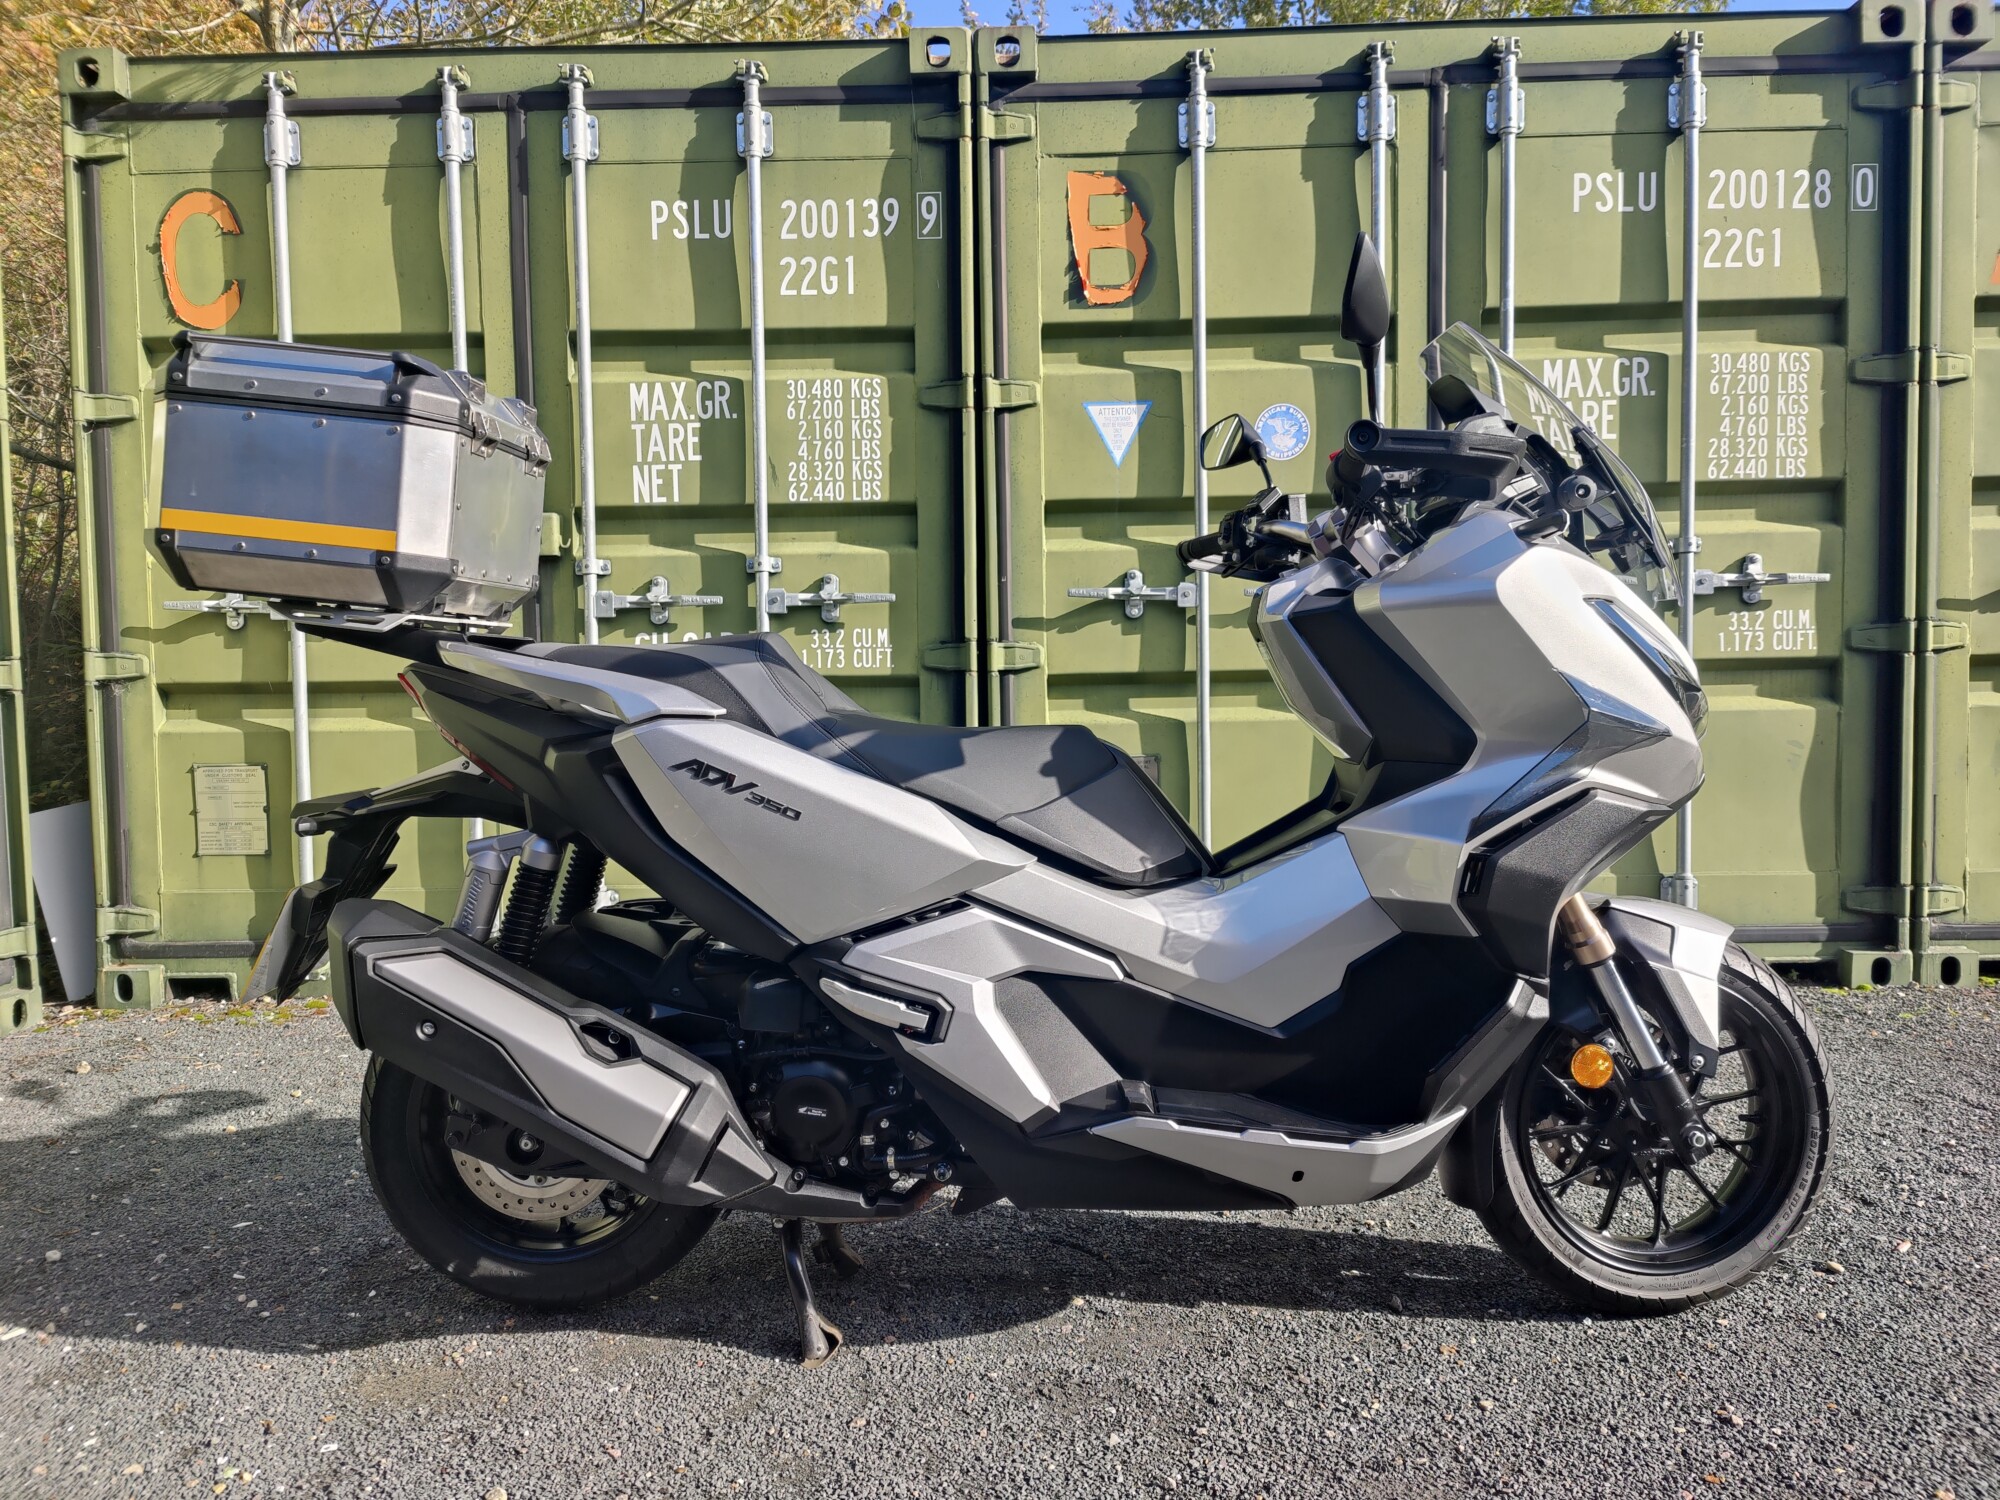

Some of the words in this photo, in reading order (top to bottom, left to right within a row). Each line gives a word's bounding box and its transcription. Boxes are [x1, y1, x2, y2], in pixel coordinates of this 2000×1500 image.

[1573, 171, 1657, 213] PSLU
[1707, 168, 1831, 210] 200128
[1855, 167, 1875, 208] 0
[650, 199, 731, 240] PSLU
[780, 198, 900, 240] 200139
[920, 195, 938, 236] 9
[1703, 227, 1782, 269] 22G1
[160, 190, 241, 330] C
[779, 255, 855, 296] 22G1
[1710, 352, 1770, 374] 30,480
[1778, 351, 1811, 373] KGS
[786, 379, 843, 400] 30,480
[851, 378, 882, 398] KGS
[1709, 373, 1770, 395] 67,200
[1777, 373, 1808, 394] LBS
[629, 380, 738, 422] MAX.GR.
[786, 399, 844, 420] 67,200
[851, 398, 881, 419] LBS
[1098, 406, 1137, 416] ATTENTION
[1720, 395, 1769, 416] 2,160
[1776, 394, 1809, 415] KGS
[798, 420, 844, 440] 2,160
[851, 419, 882, 440] KGS
[1288, 406, 1309, 433] BUREAU
[1719, 416, 1769, 437] 4,760
[1776, 415, 1807, 436] LBS
[631, 422, 702, 463] TARE
[797, 440, 844, 461] 4,760
[851, 439, 881, 460] LBS
[1708, 437, 1768, 458] 28,320
[1776, 437, 1808, 457] KGS
[788, 461, 844, 481] 28,320
[852, 460, 883, 480] KGS
[1707, 458, 1768, 479] 62,440
[1775, 458, 1807, 479] LBS
[632, 463, 683, 504] NET
[788, 481, 845, 502] 62,440
[852, 481, 882, 501] LBS
[1728, 610, 1764, 631] 33.2
[1772, 609, 1815, 630] CU.M.
[810, 628, 845, 648] 33.2
[852, 627, 893, 648] CU.M.
[1718, 631, 1764, 652] 1,173
[1772, 629, 1817, 651] CU.FT.
[853, 648, 895, 668] CU.FT.
[667, 758, 761, 796] ADV
[744, 791, 802, 822] 350
[1518, 1191, 1578, 1262] METZELER
